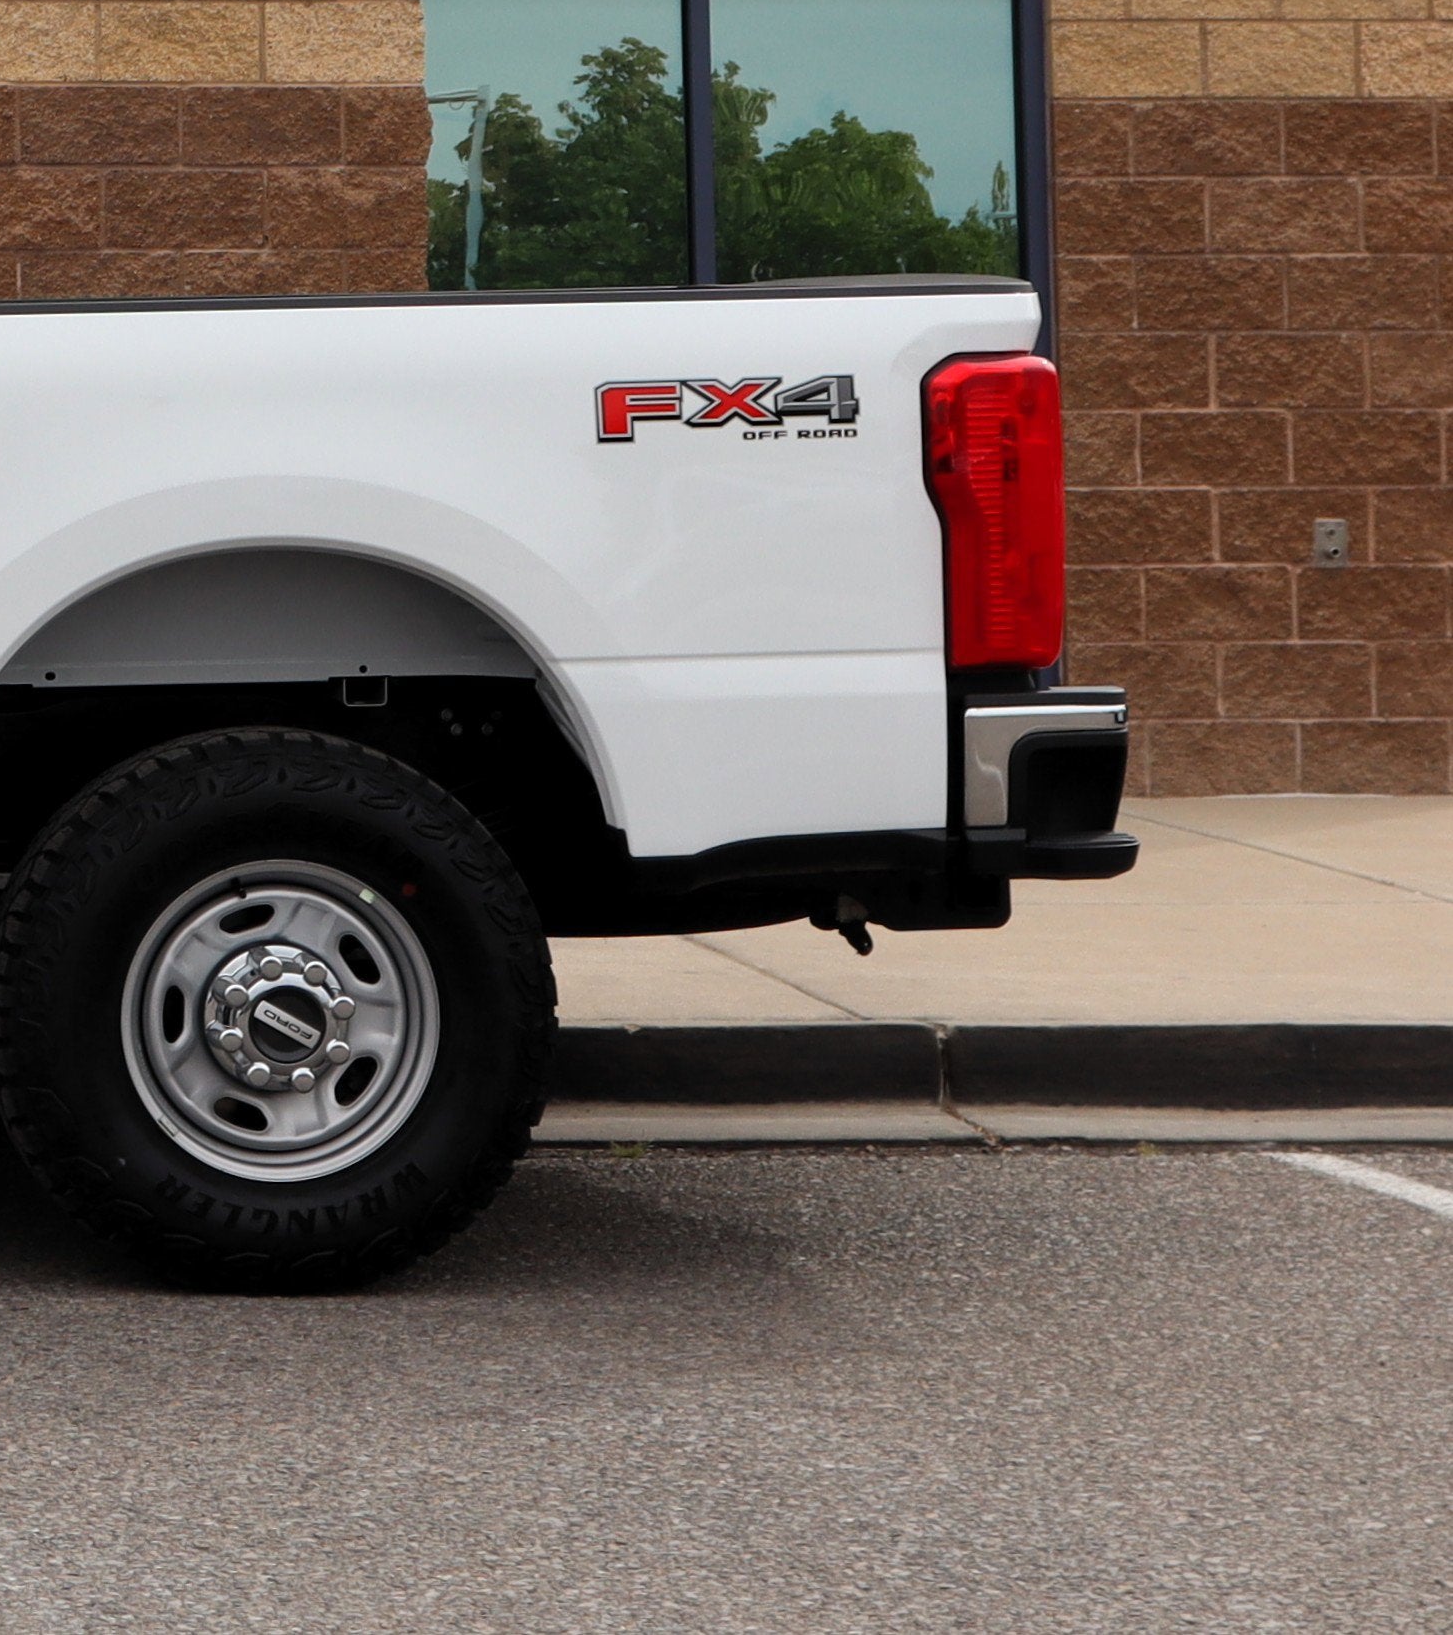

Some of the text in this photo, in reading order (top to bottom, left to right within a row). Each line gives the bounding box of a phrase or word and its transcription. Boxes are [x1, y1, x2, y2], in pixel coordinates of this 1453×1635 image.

[594, 375, 860, 444] FX4
[742, 428, 859, 441] OFF ROAD
[263, 1009, 314, 1039] FORD
[153, 1159, 430, 1238] WRANGLER
